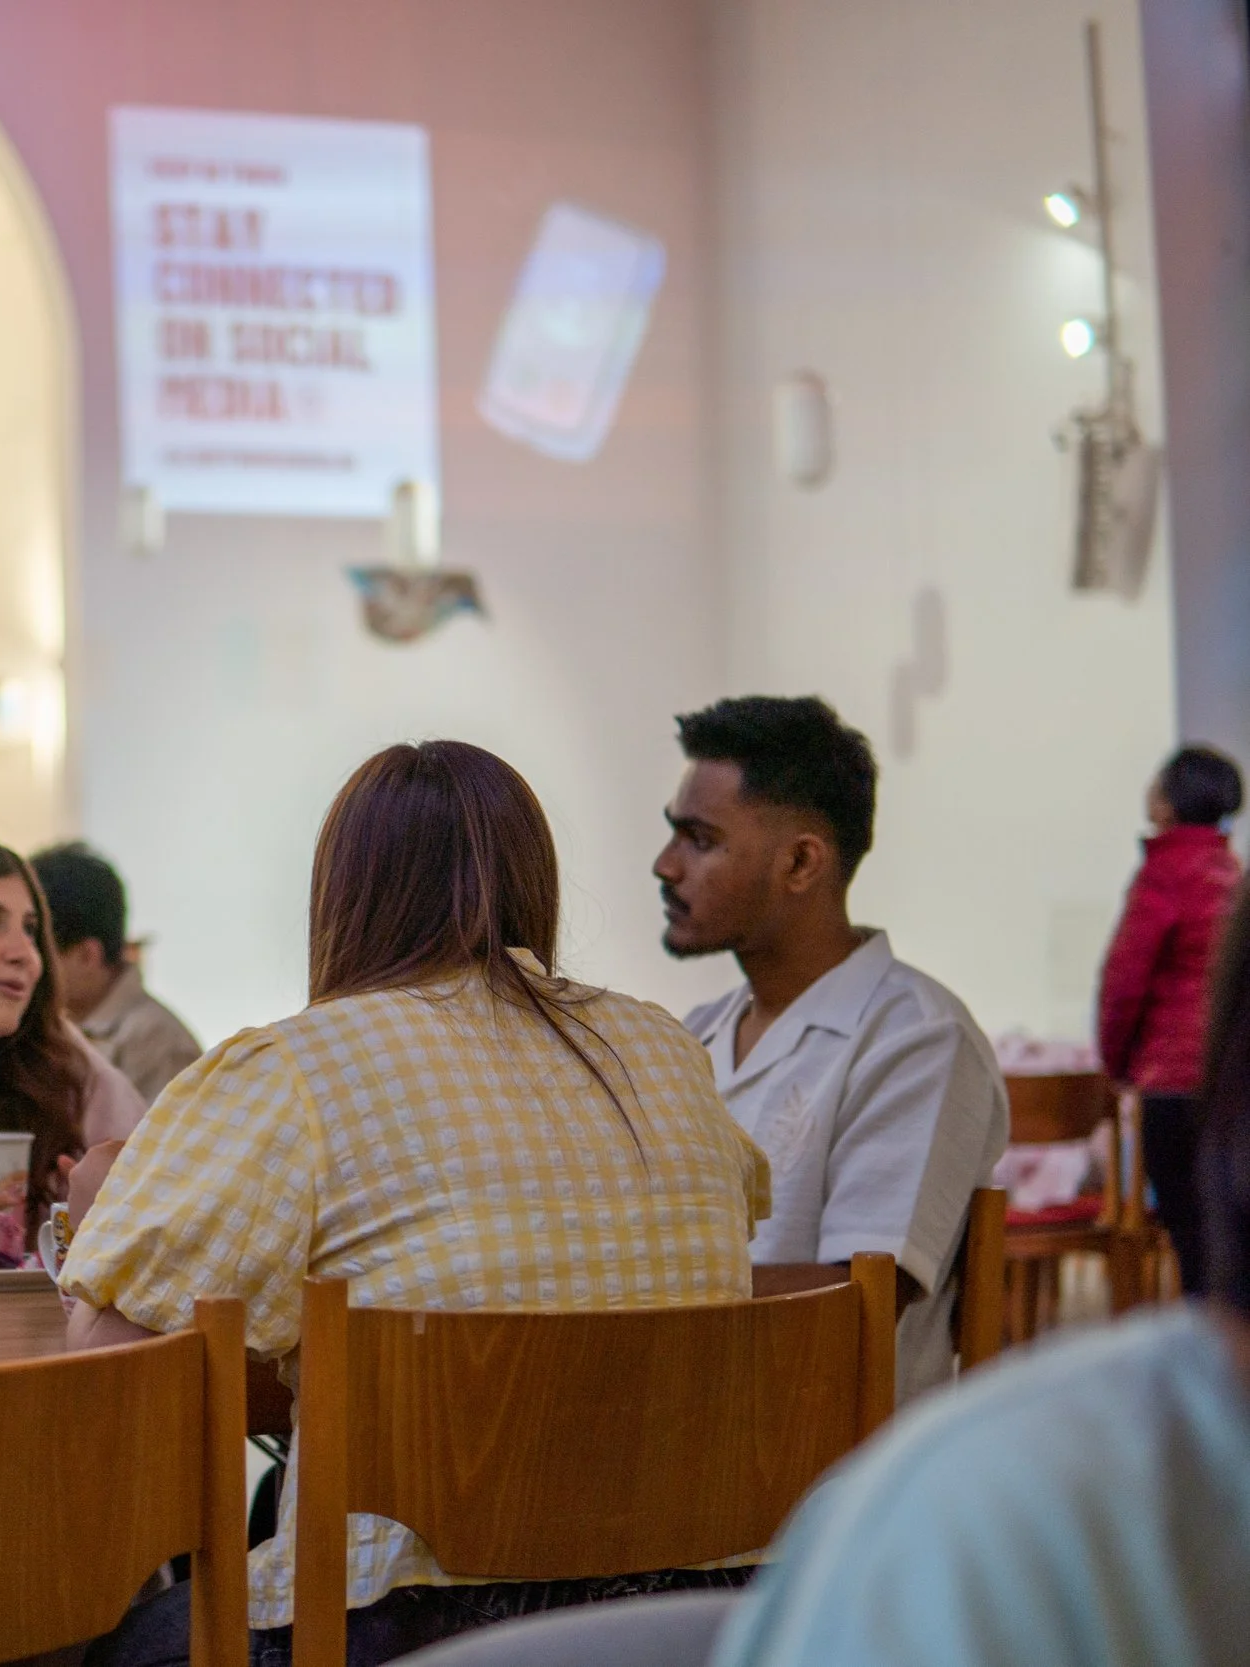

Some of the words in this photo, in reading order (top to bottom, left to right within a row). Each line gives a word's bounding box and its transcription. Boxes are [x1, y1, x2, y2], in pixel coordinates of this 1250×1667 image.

[154, 202, 264, 252] STAY
[154, 260, 401, 318] CONNECTED
[159, 318, 213, 364] ON
[230, 321, 374, 374] SOCIAL
[156, 374, 288, 424] MEDIA
